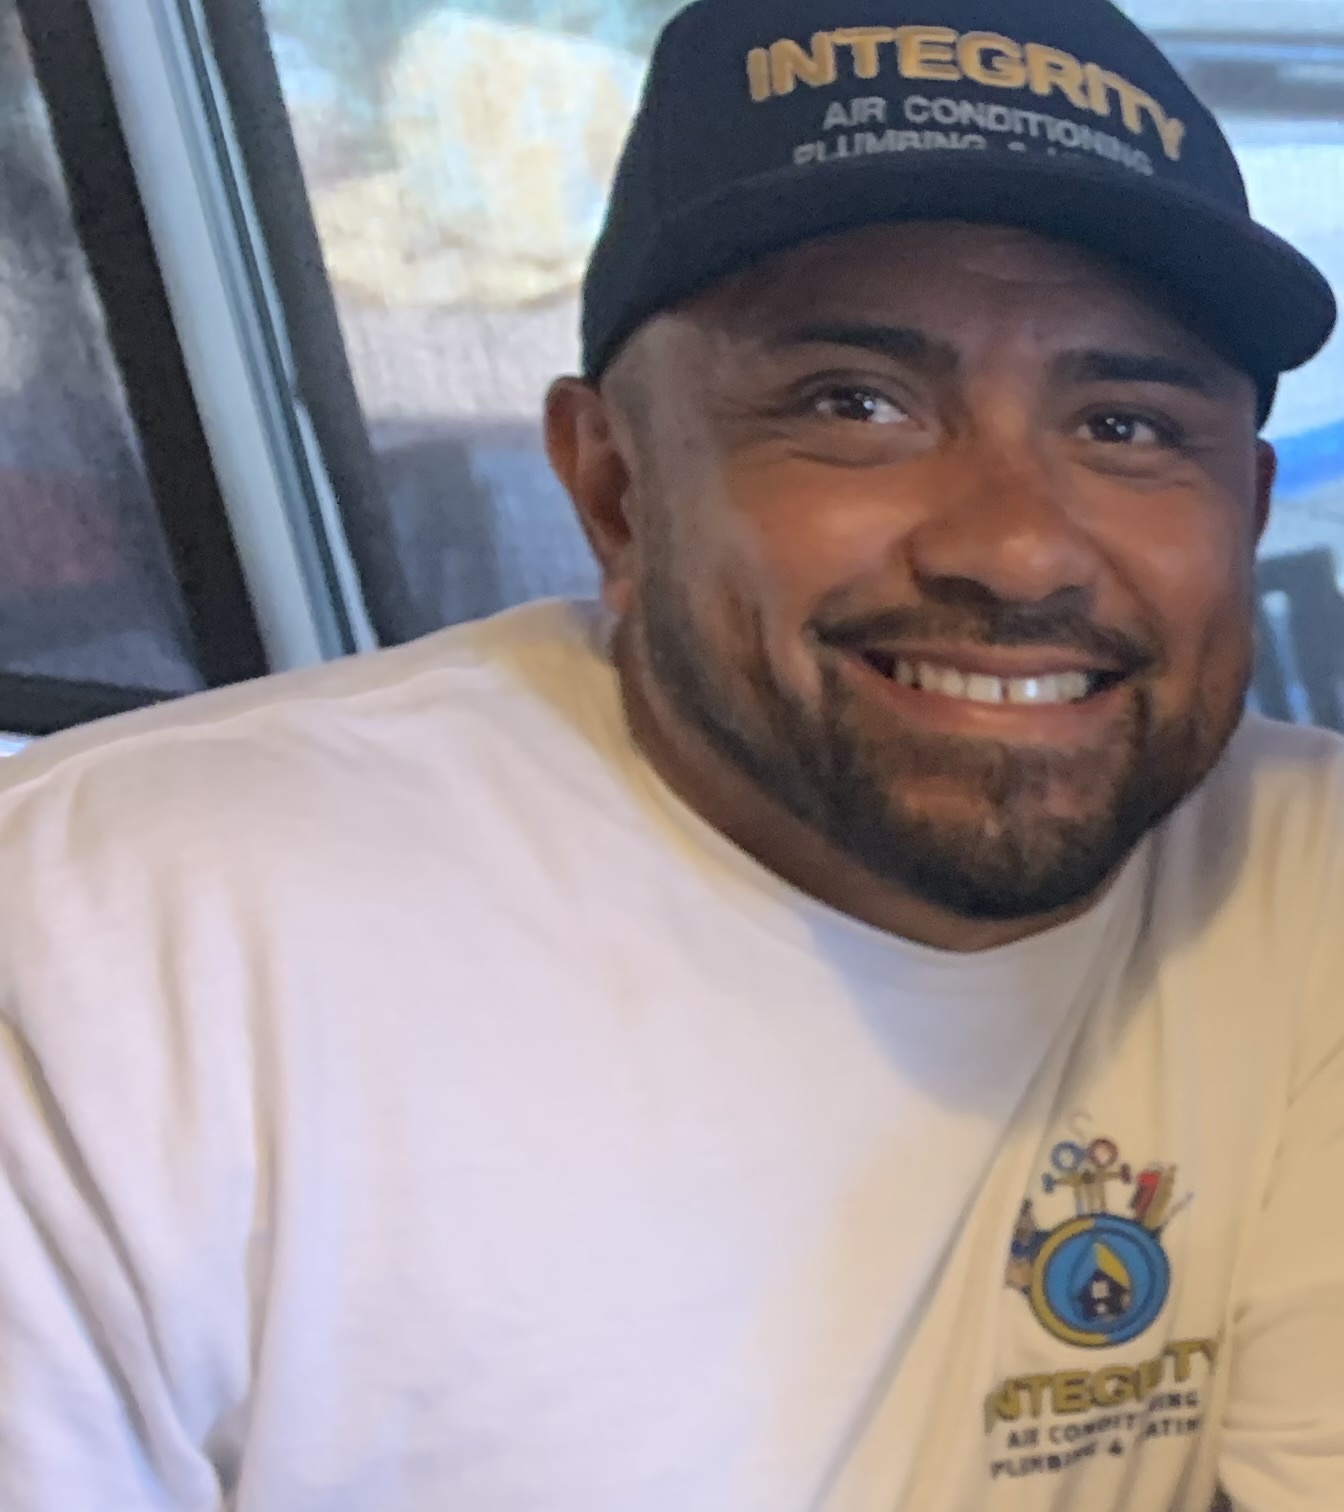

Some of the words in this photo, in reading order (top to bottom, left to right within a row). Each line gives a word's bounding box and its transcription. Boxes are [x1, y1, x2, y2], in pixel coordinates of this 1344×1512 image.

[745, 25, 1186, 161] INTEGRITY
[823, 96, 887, 130] AIR
[904, 95, 1153, 175] CONDITIONING
